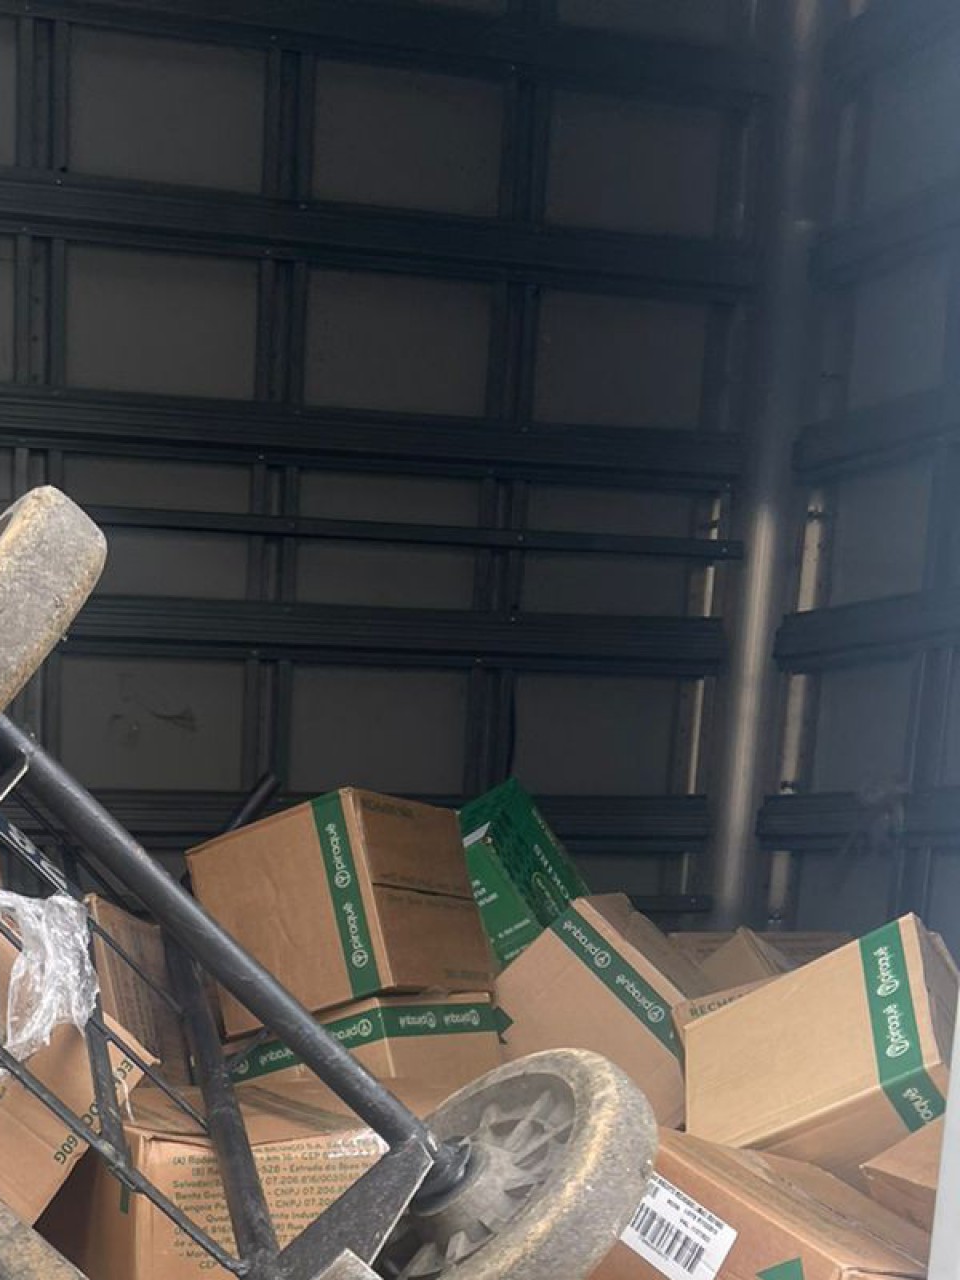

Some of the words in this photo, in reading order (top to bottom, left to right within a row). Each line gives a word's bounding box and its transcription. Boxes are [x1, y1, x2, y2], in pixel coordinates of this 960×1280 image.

[324, 823, 346, 870] piraquê
[343, 902, 364, 949] piraquê
[561, 920, 598, 956] piraquê
[615, 973, 651, 1013] piraquê
[902, 1086, 936, 1120] aquê
